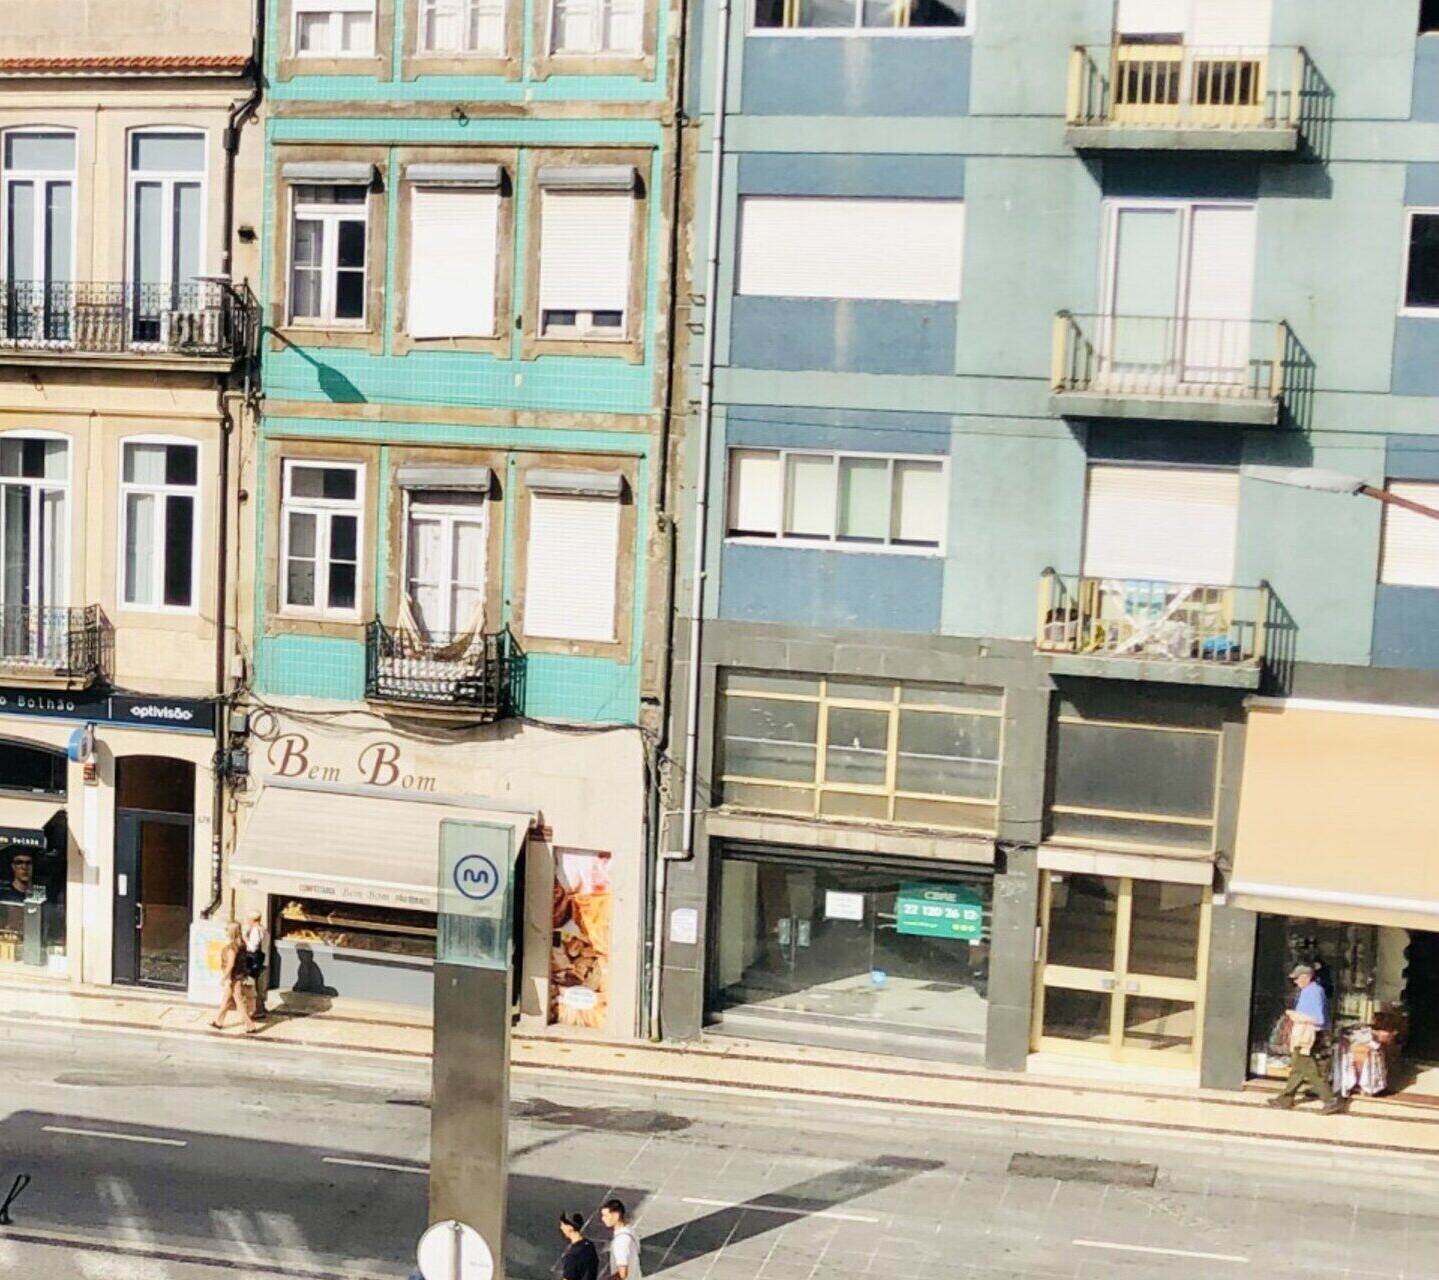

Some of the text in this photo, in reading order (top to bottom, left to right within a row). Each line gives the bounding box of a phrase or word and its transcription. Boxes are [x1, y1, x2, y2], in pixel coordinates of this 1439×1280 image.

[17, 694, 76, 712] Bolhão
[267, 732, 437, 792] Bem Bom
